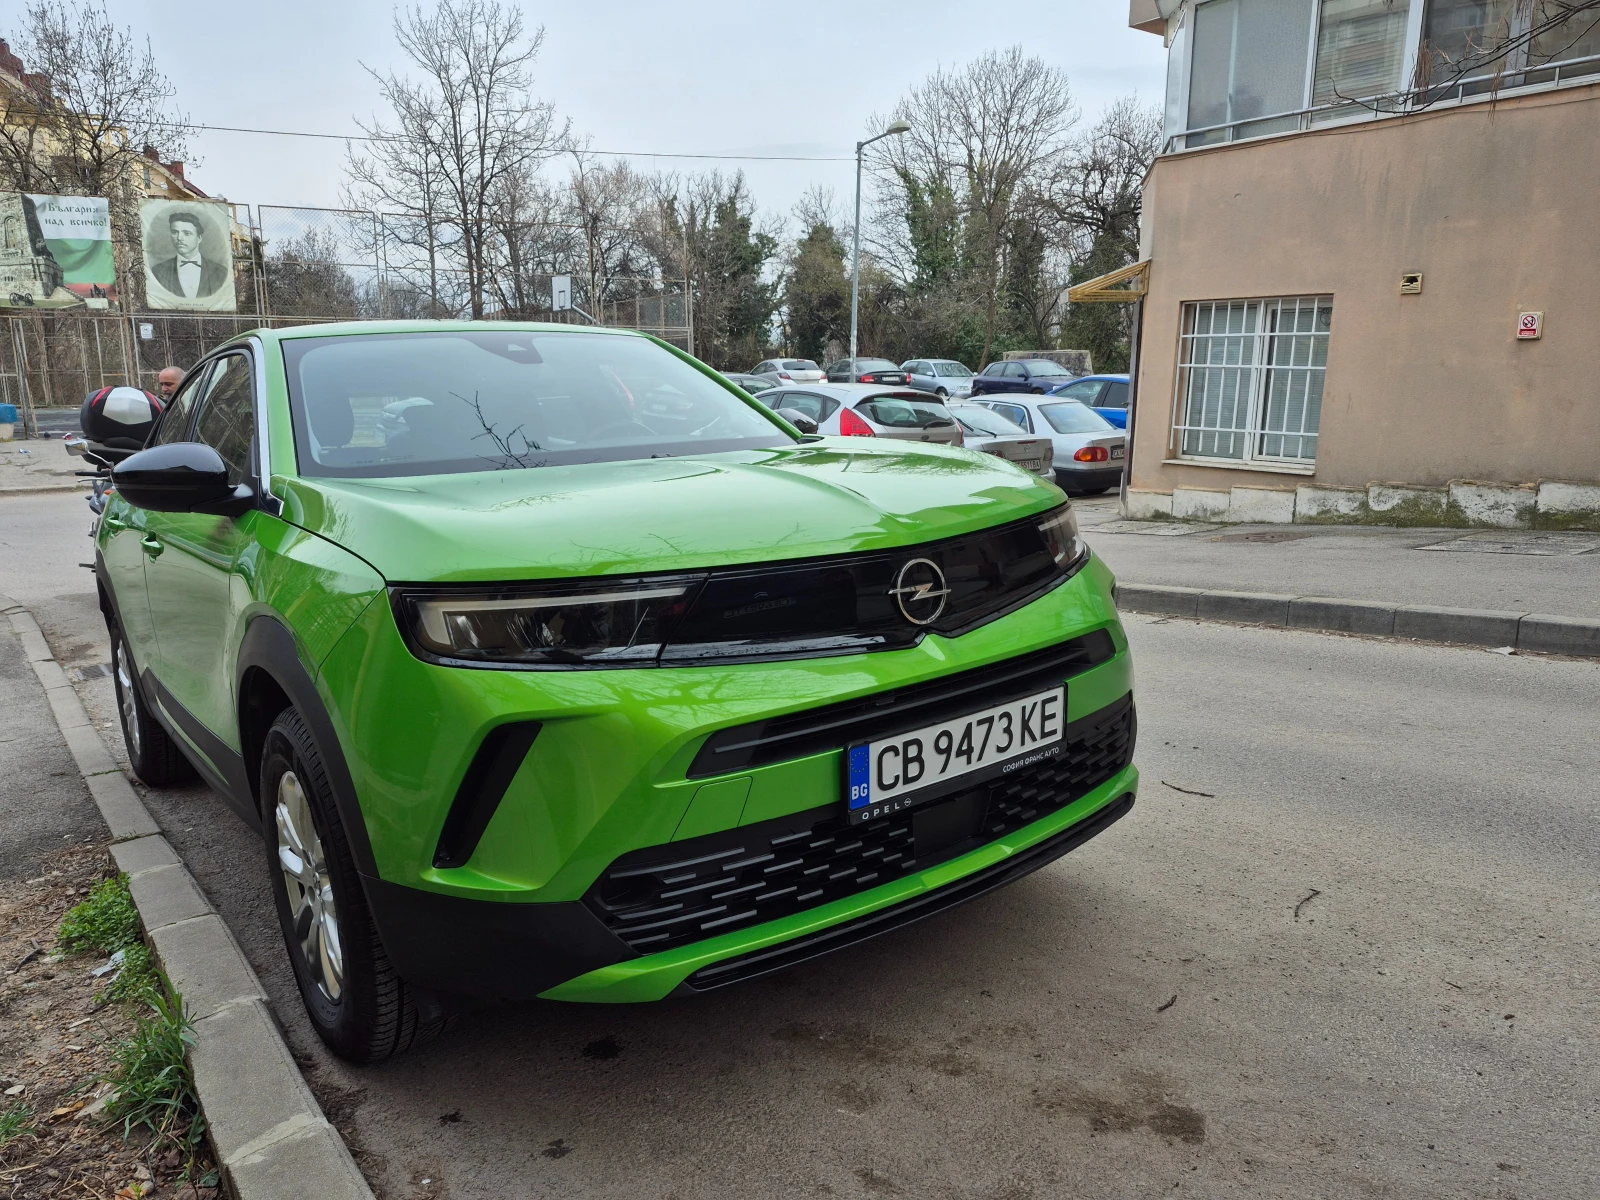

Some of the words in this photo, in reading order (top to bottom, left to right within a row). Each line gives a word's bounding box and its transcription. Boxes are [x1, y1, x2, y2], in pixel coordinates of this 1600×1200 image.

[47, 202, 99, 215] България
[44, 218, 65, 226] над
[70, 217, 107, 227] всичко!
[877, 737, 925, 791] CB
[934, 711, 1014, 774] 9473
[1020, 695, 1059, 747] KE
[1002, 759, 1024, 773] СОФИЯ
[851, 783, 868, 800] BG
[862, 802, 900, 820] OPEL
